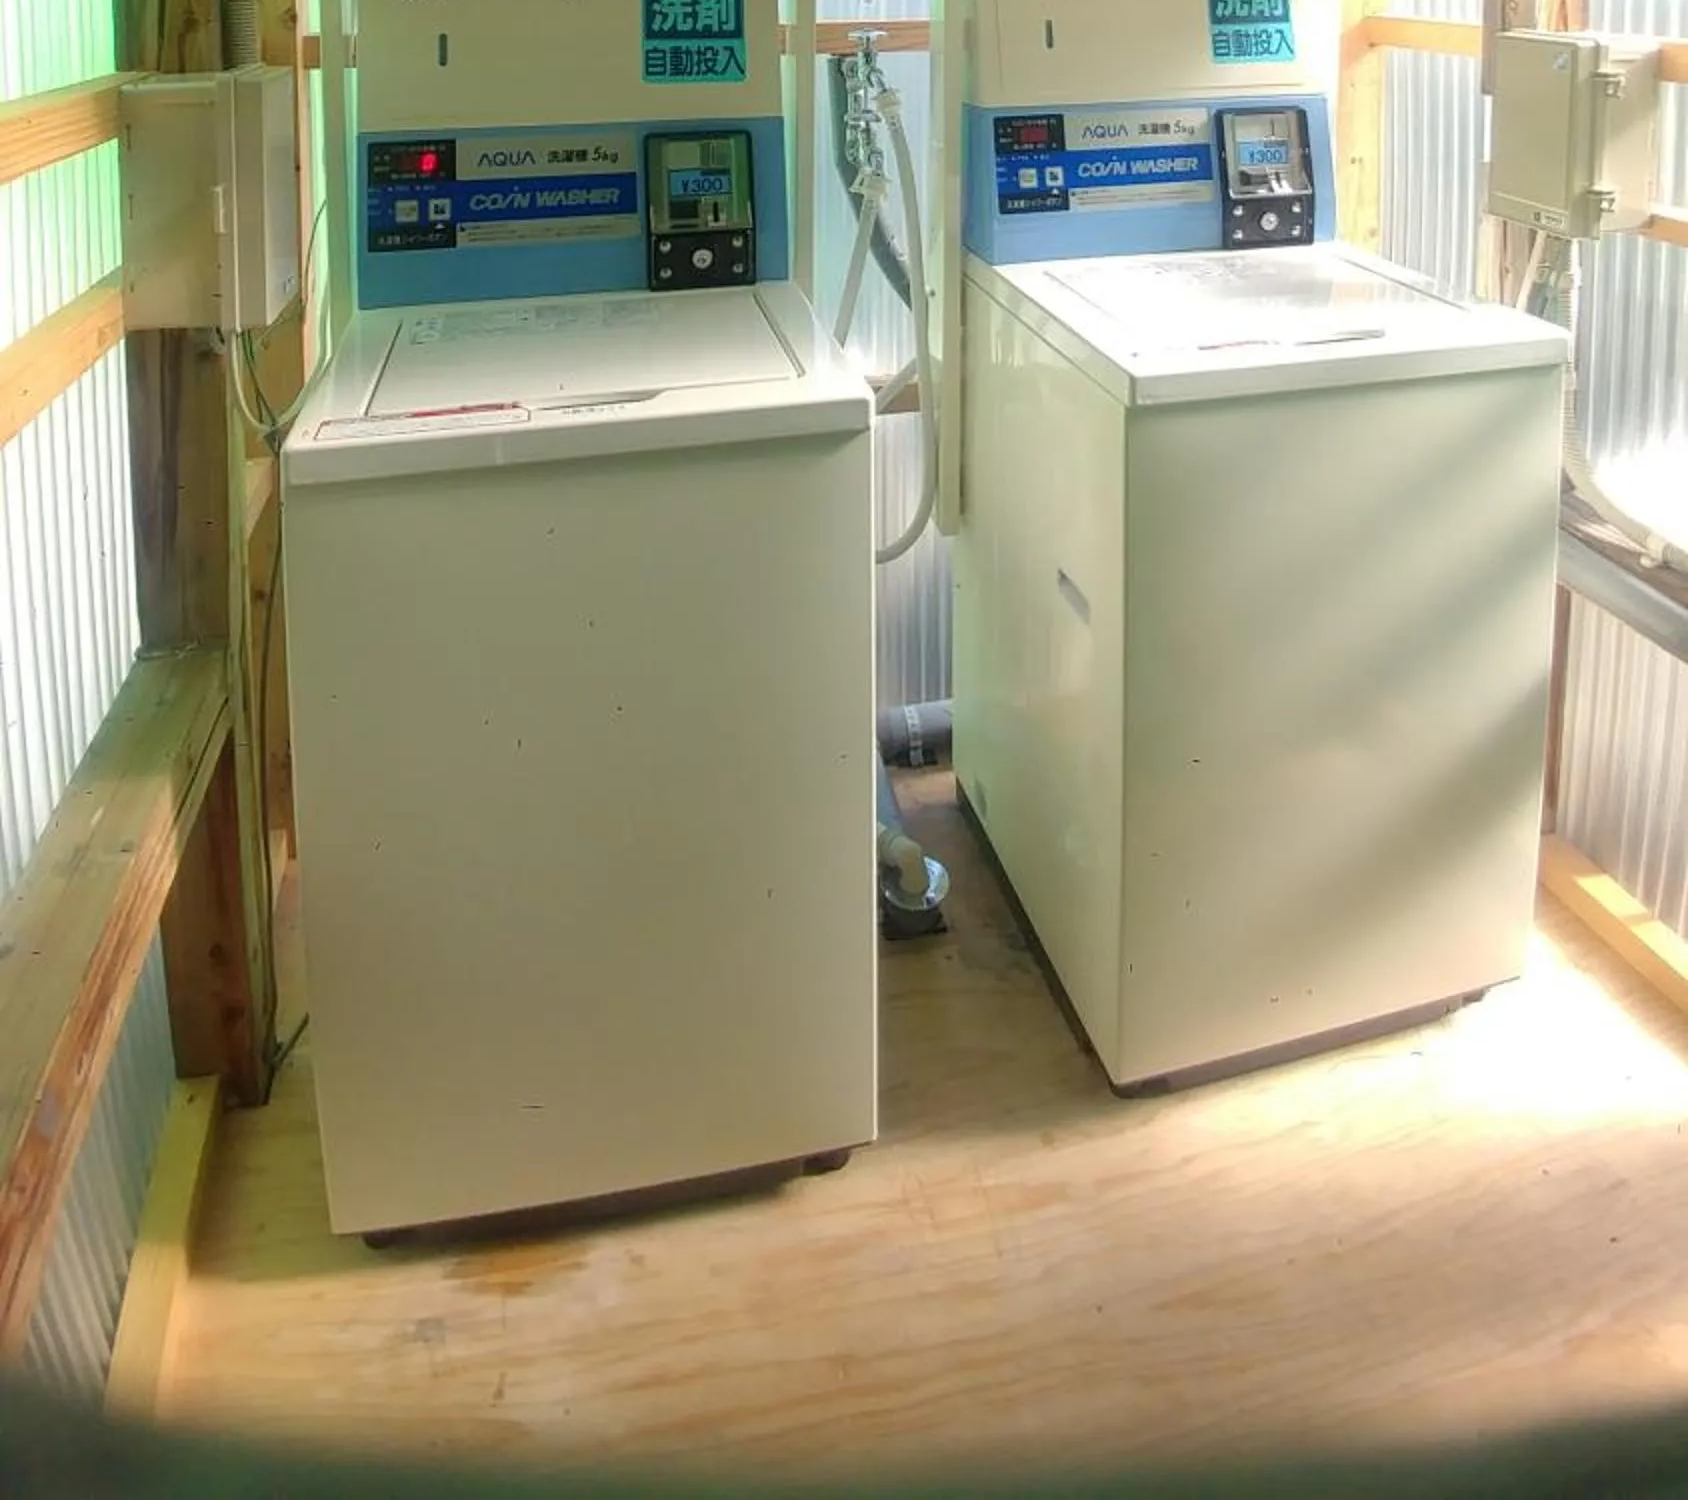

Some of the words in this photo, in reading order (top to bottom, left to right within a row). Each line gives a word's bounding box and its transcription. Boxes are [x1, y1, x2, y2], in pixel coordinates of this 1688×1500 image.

[1212, 29, 1294, 57] 自動投入
[644, 45, 745, 77] 自動投入
[1081, 122, 1129, 140] AQUA
[477, 150, 536, 168] AQUA
[592, 145, 619, 164] 5kg
[1077, 155, 1127, 177] COIN
[1129, 156, 1199, 174] WASHER
[469, 185, 530, 211] COIN
[535, 188, 620, 208] WASHER
